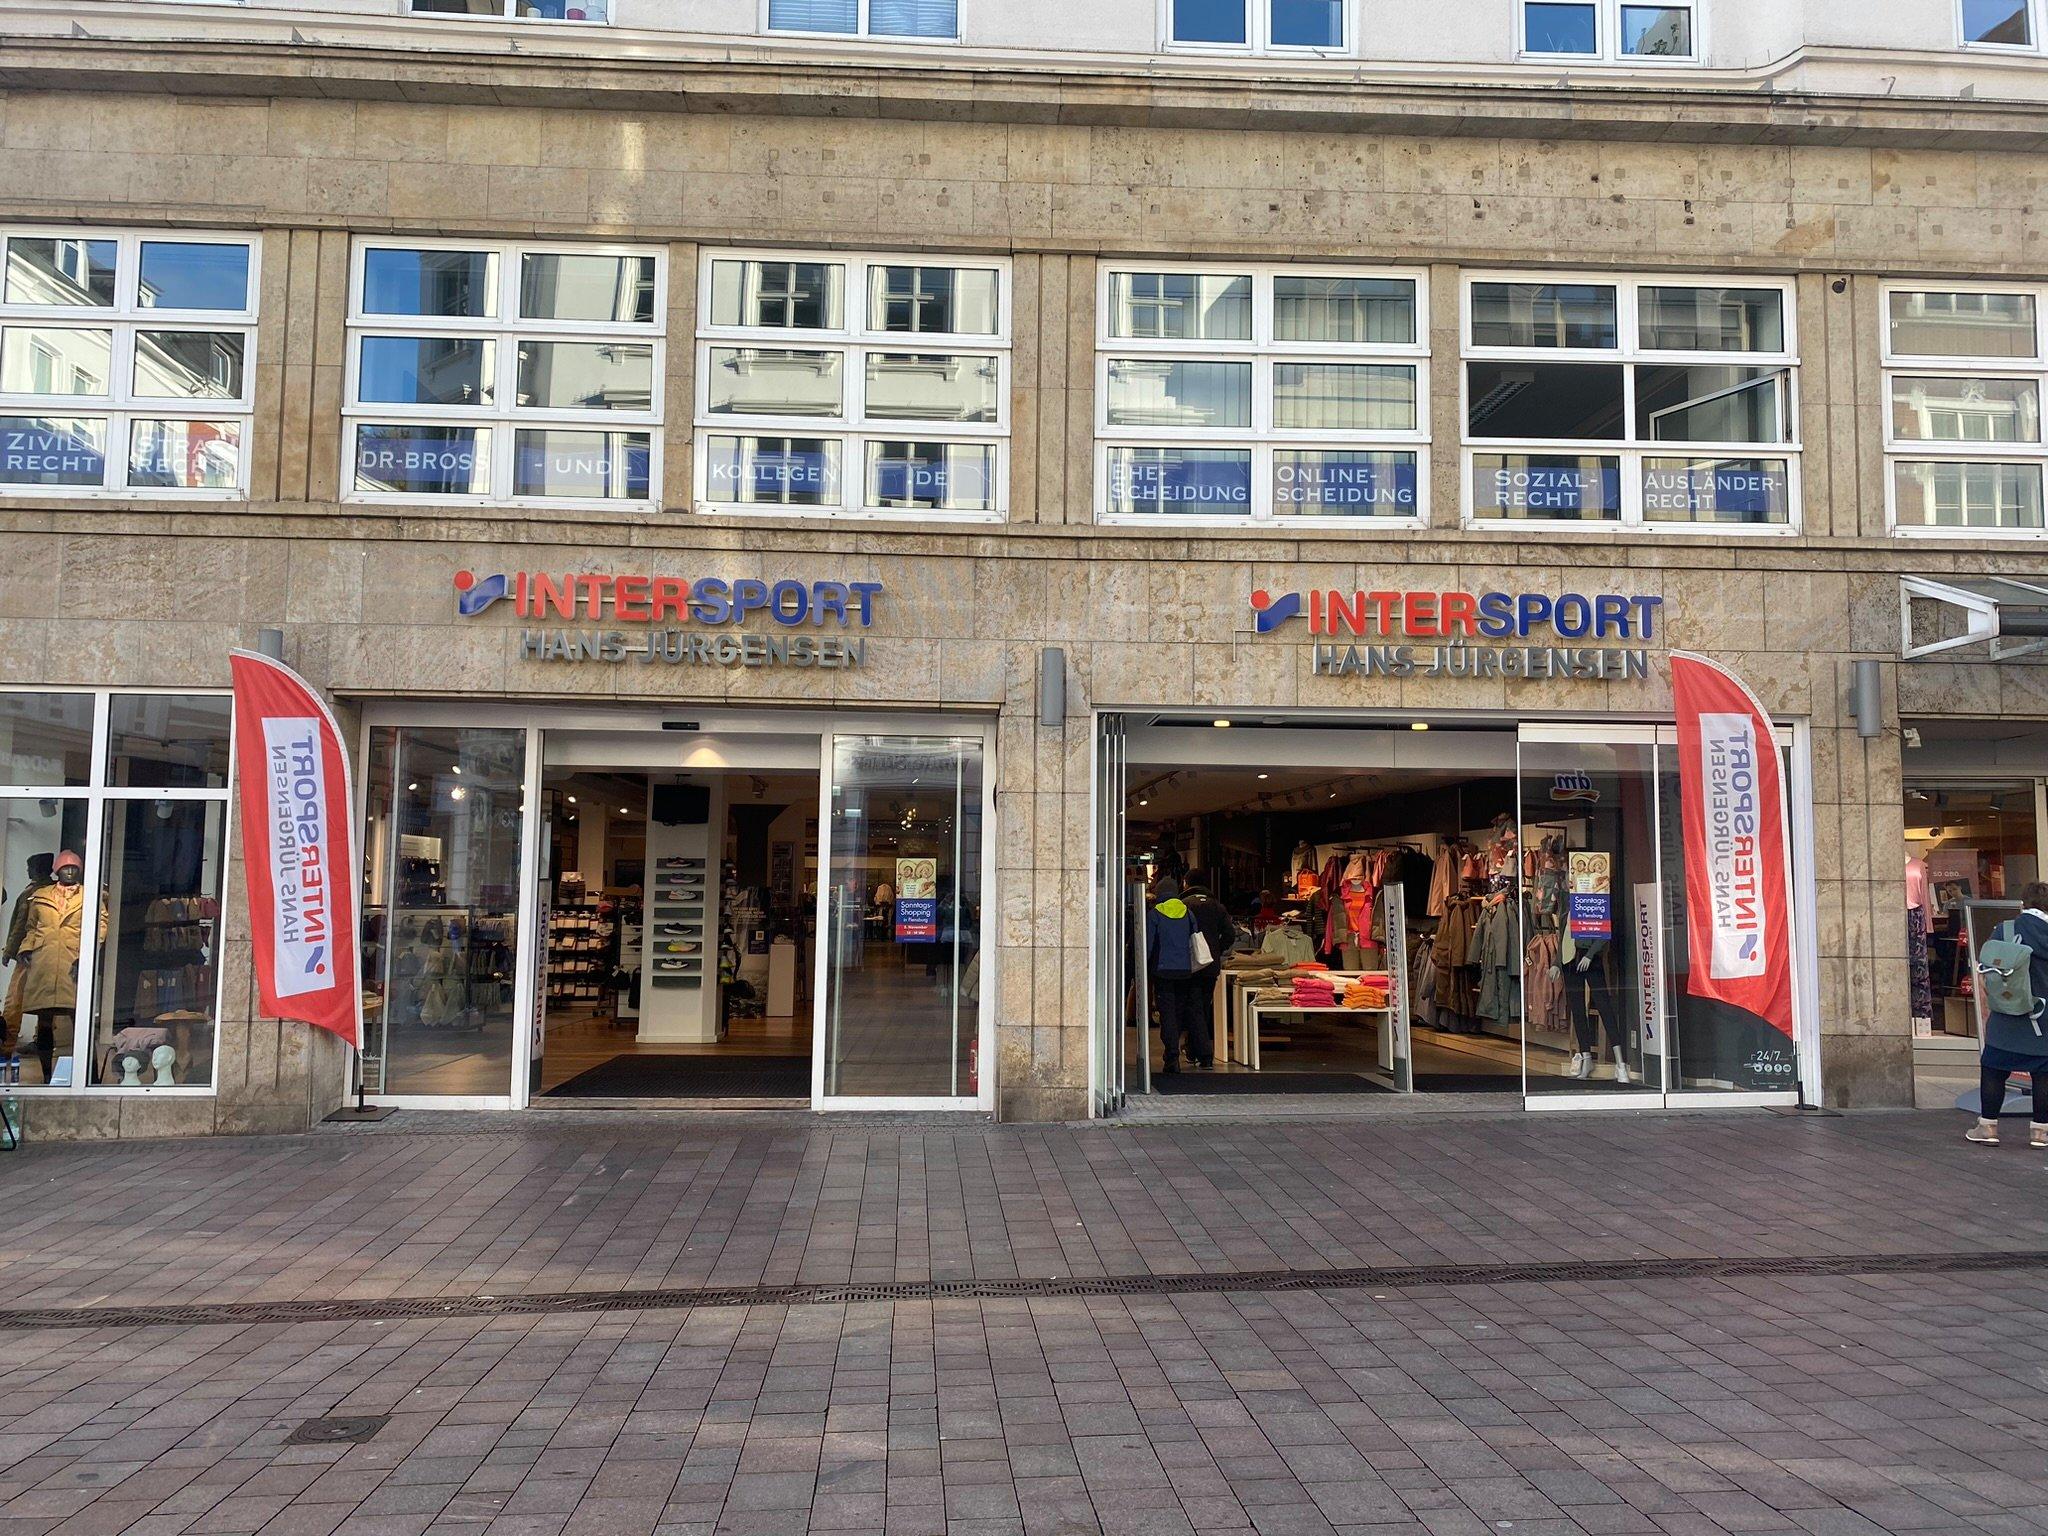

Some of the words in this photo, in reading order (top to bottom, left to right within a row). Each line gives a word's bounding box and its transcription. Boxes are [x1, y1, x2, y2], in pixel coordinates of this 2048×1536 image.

[137, 436, 212, 454] STRA
[7, 455, 97, 471] RECHT
[361, 450, 488, 471] DR-BROSS
[555, 458, 611, 474] UND
[711, 463, 838, 483] KOLLEGEN
[1111, 463, 1167, 481] EHE-
[1276, 466, 1378, 483] ONLINE-
[1494, 469, 1598, 488] SOZIAL-
[1644, 471, 1783, 491] AUSLÄNDER-
[1111, 482, 1247, 501] SCHEIDUNG
[1276, 487, 1413, 503] SCHEIDUNG
[1494, 491, 1579, 507] RECHT
[1645, 494, 1714, 510] RECHT
[514, 571, 884, 629] INTERSPORT
[1307, 589, 1663, 641] INTERSPORT
[519, 628, 628, 663] HANS
[636, 627, 868, 669] JÜRGENSEN
[1312, 643, 1417, 678] HANS
[1424, 639, 1649, 680] JÜRGENSEN
[901, 901, 933, 910] Sonntags-
[1575, 896, 1607, 905] Sonntags-
[1575, 904, 1606, 913] Shopping
[901, 908, 931, 917] Shopping
[1639, 900, 1652, 1021] INTERSPORT
[1756, 1050, 1781, 1061] 24/7
